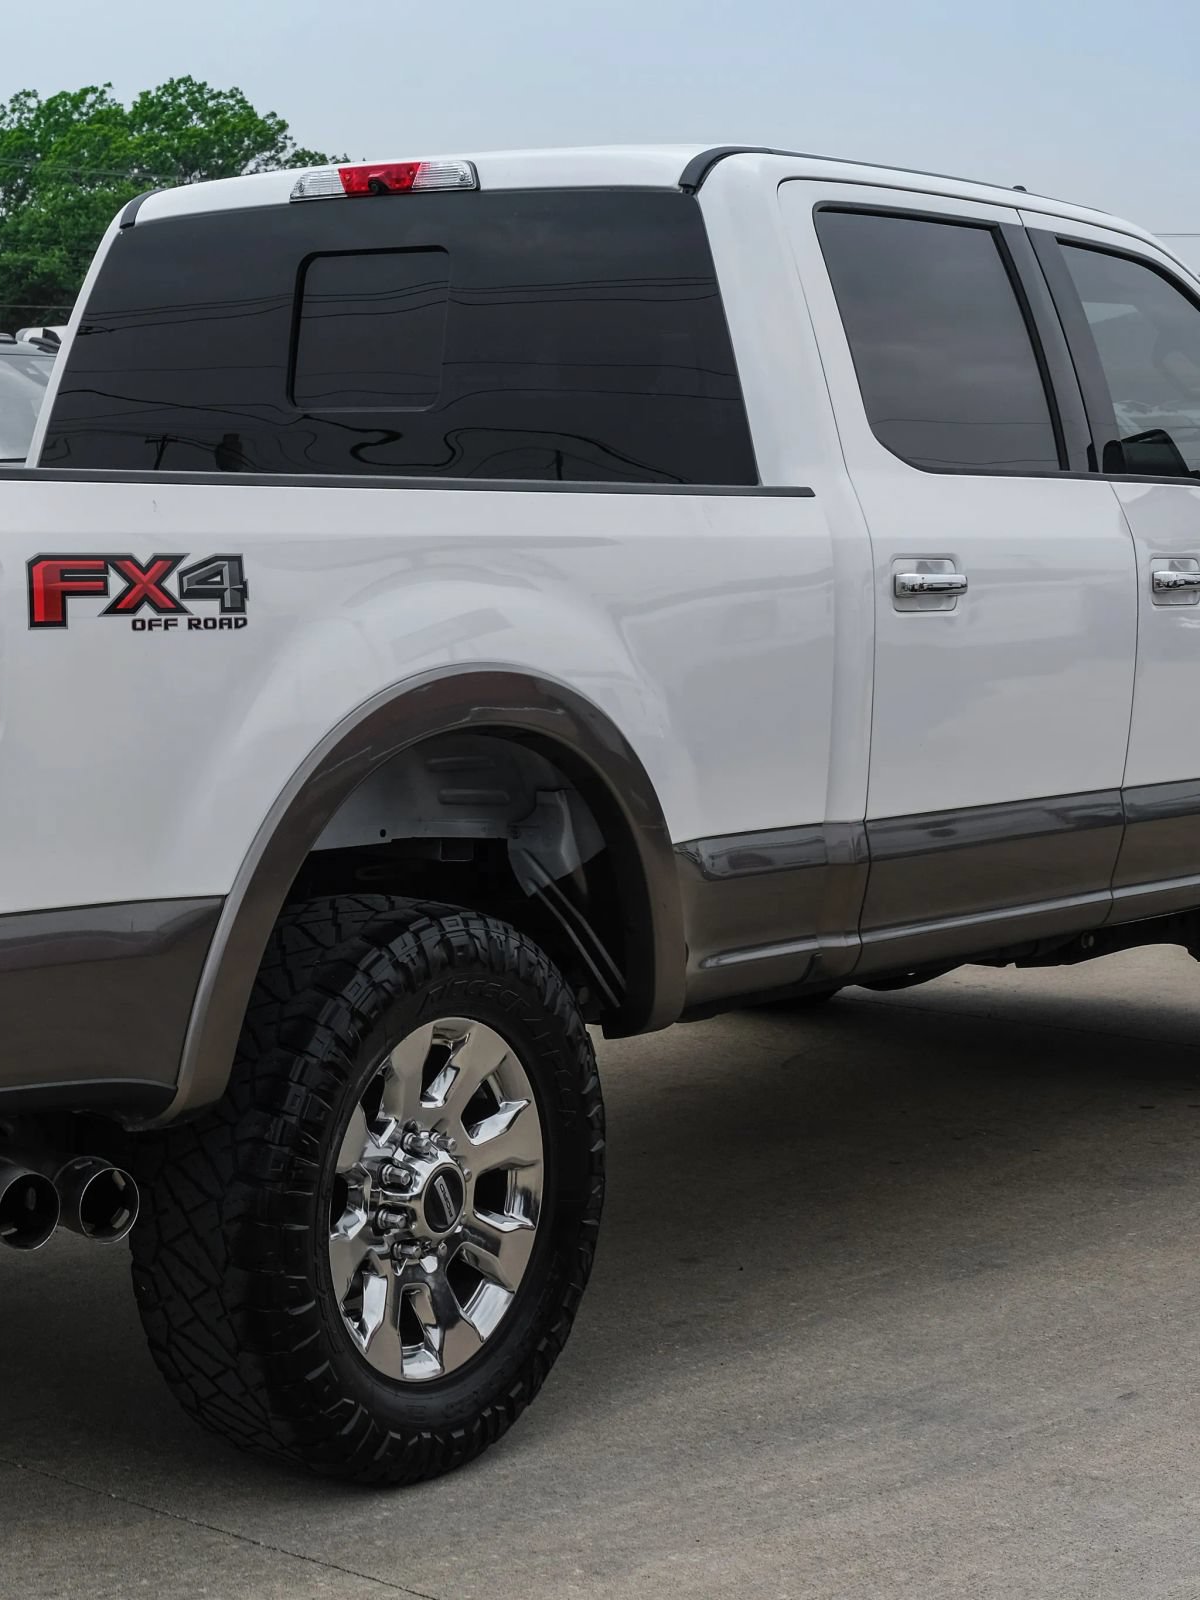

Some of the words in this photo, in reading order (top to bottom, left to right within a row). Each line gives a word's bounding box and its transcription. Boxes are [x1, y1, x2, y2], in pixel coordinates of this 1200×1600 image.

[26, 553, 249, 629] FX4
[131, 617, 178, 631] OFF
[187, 617, 248, 631] ROAD
